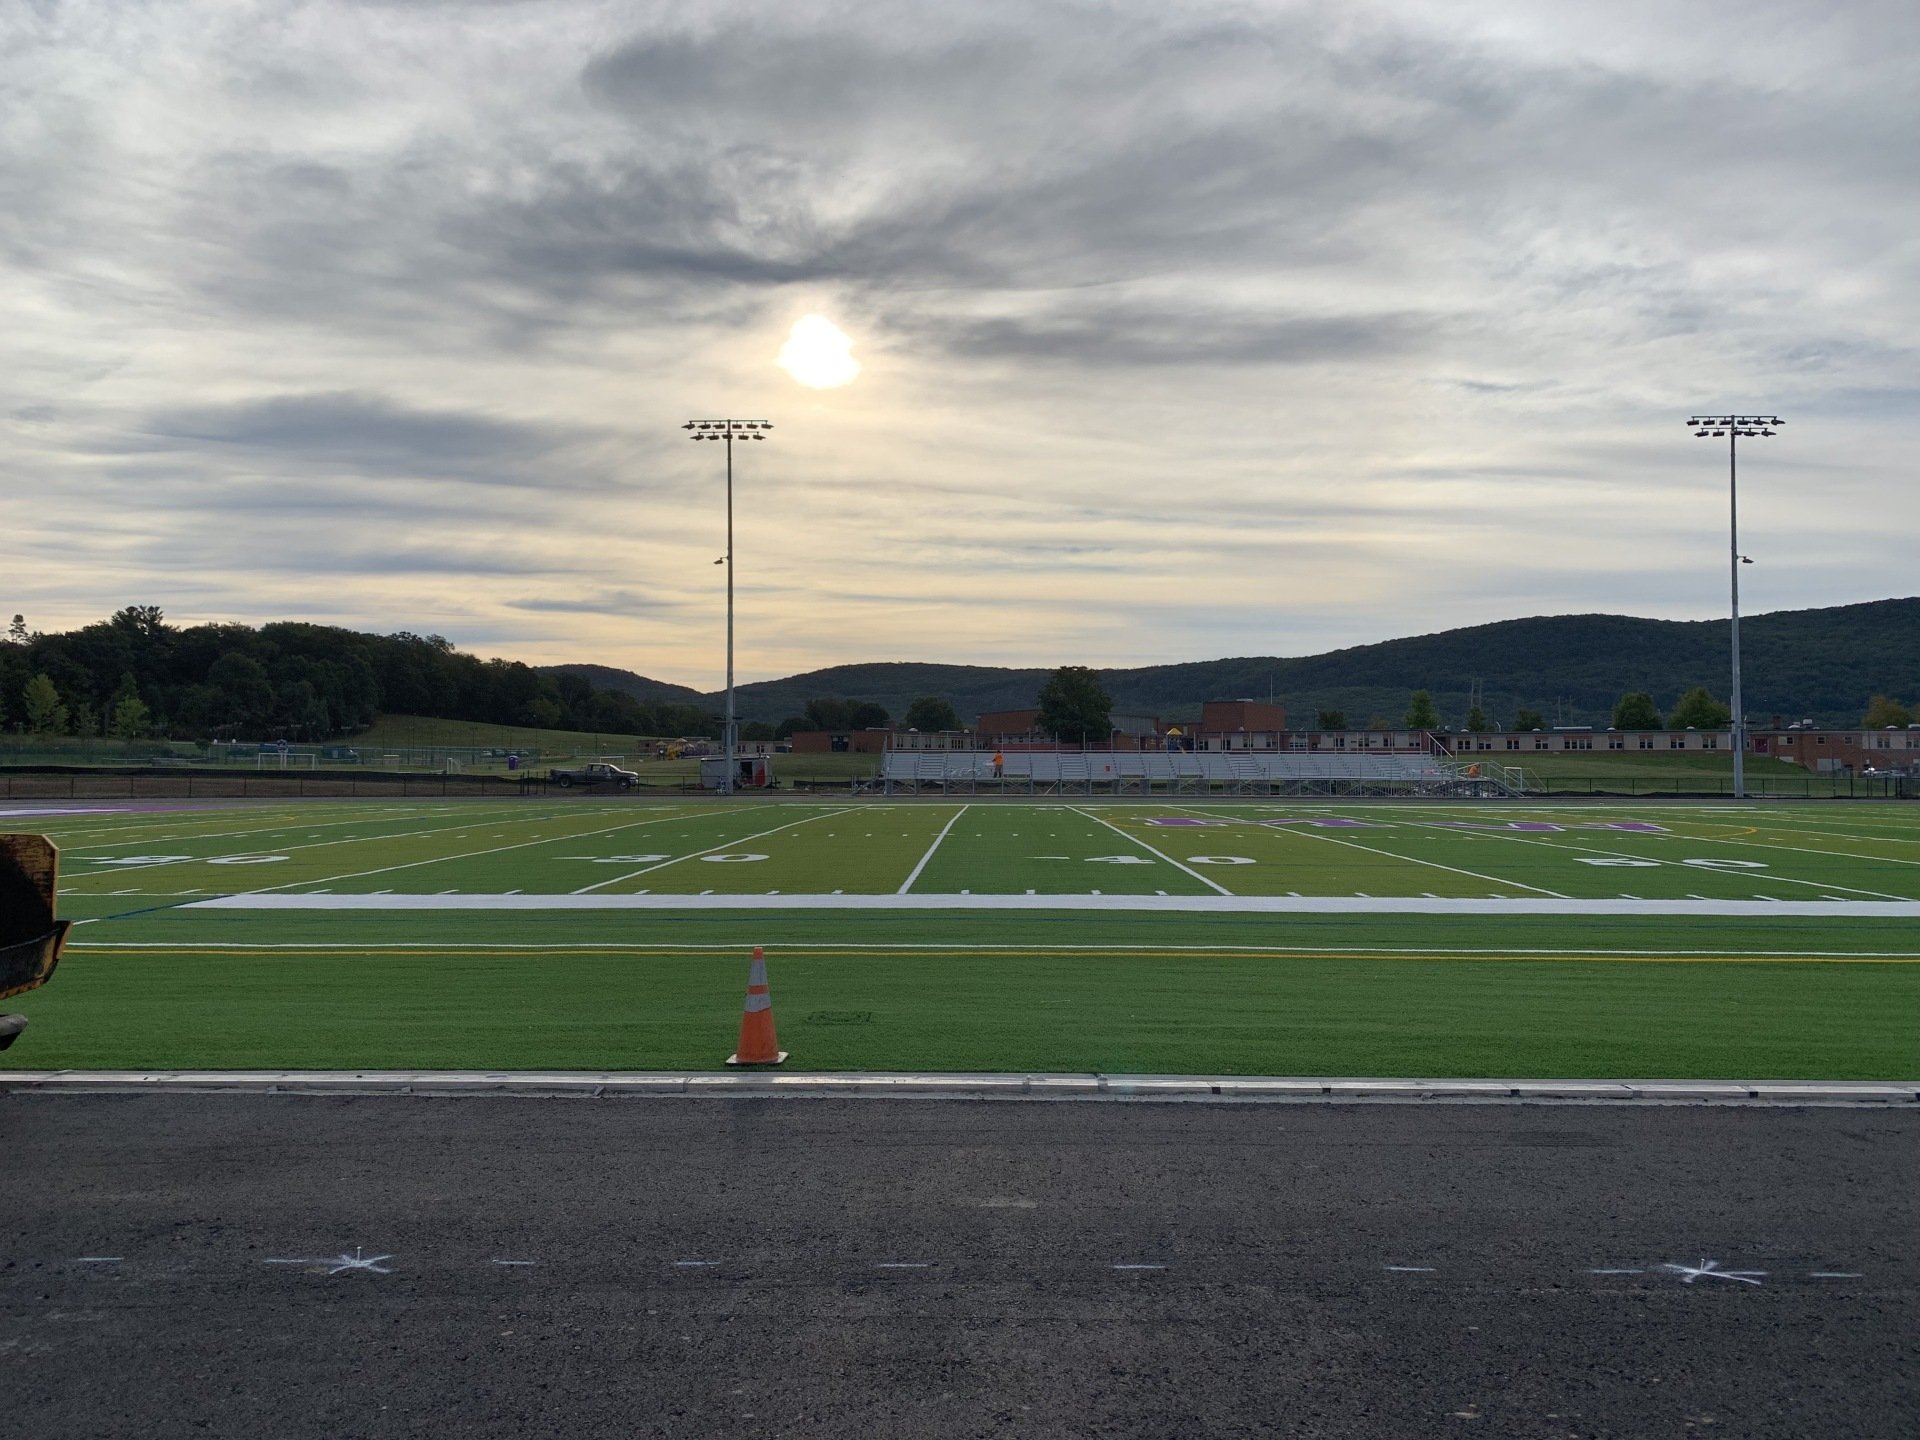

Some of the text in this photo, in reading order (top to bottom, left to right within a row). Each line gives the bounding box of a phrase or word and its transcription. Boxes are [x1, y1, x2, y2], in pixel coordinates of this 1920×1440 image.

[592, 854, 769, 863] 30
[1084, 855, 1257, 864] 40
[1572, 858, 1769, 867] 50
